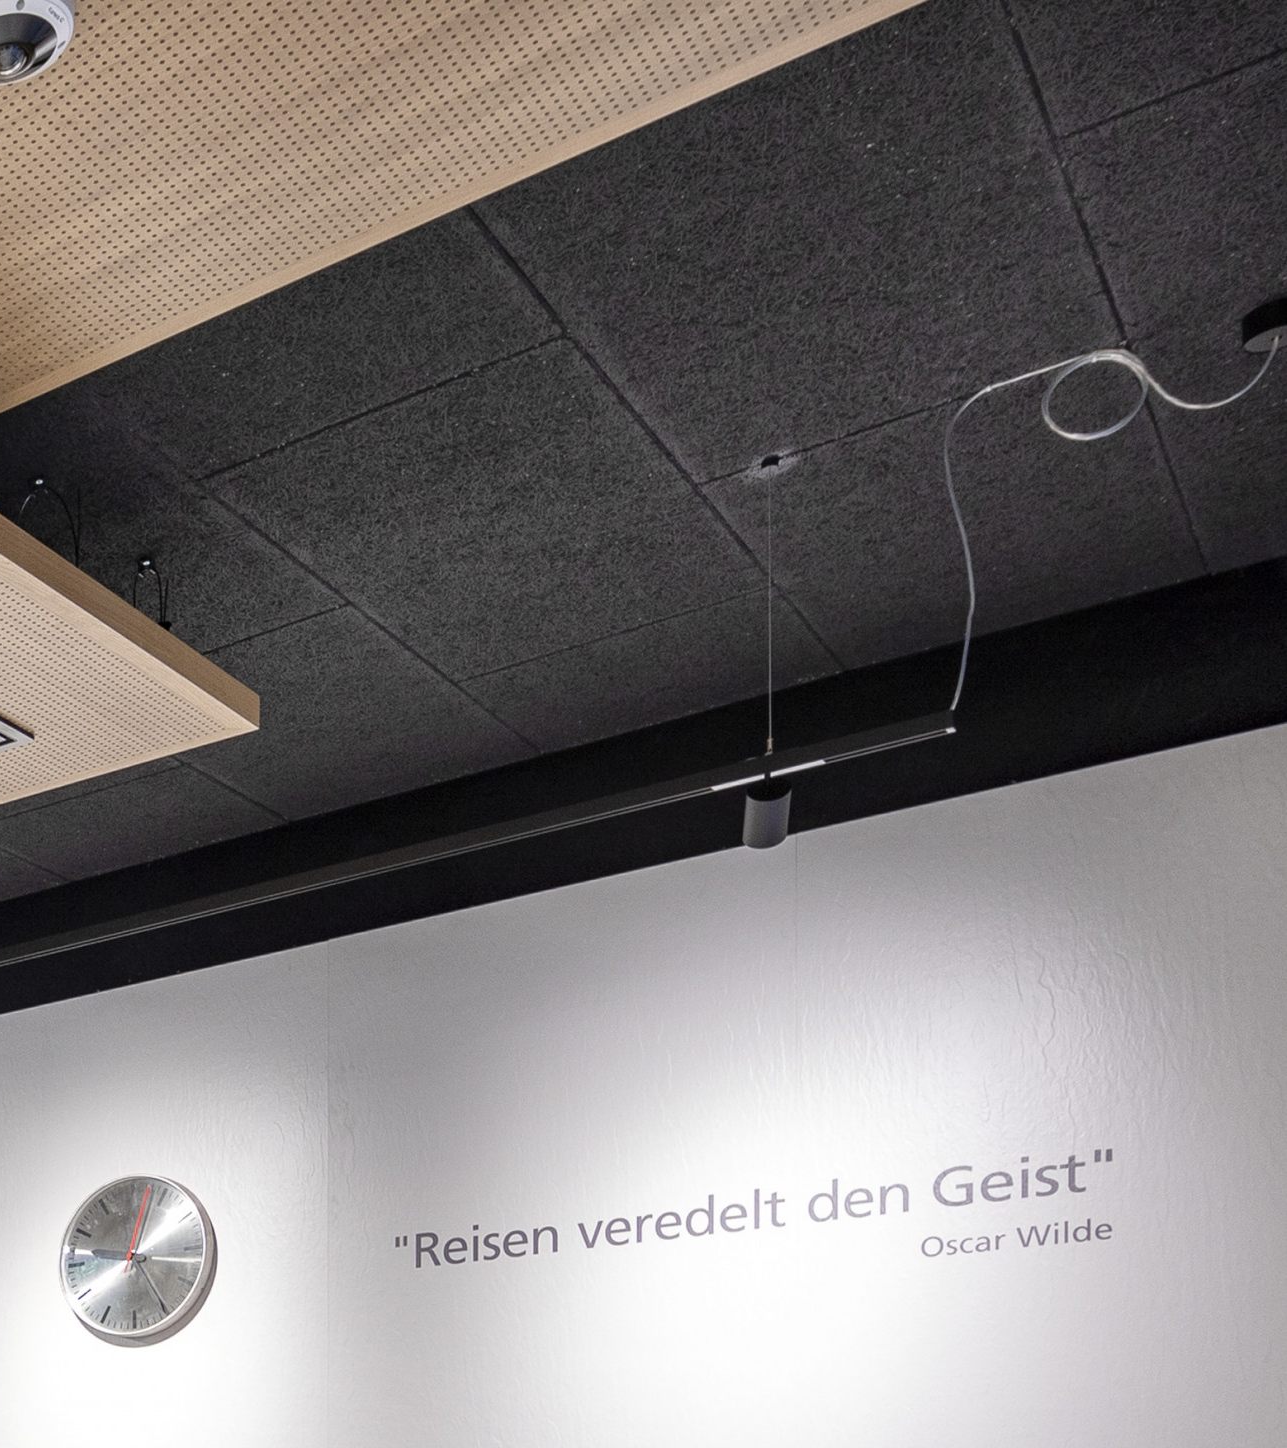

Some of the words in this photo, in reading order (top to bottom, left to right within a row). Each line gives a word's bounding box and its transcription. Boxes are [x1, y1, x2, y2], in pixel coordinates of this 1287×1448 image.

[395, 1223, 559, 1269] "Reisen
[577, 1188, 786, 1249] veredelt
[807, 1177, 910, 1223] den
[932, 1148, 1114, 1208] Geist"
[920, 1233, 1007, 1258] Oscar
[1017, 1217, 1113, 1247] Wilde
